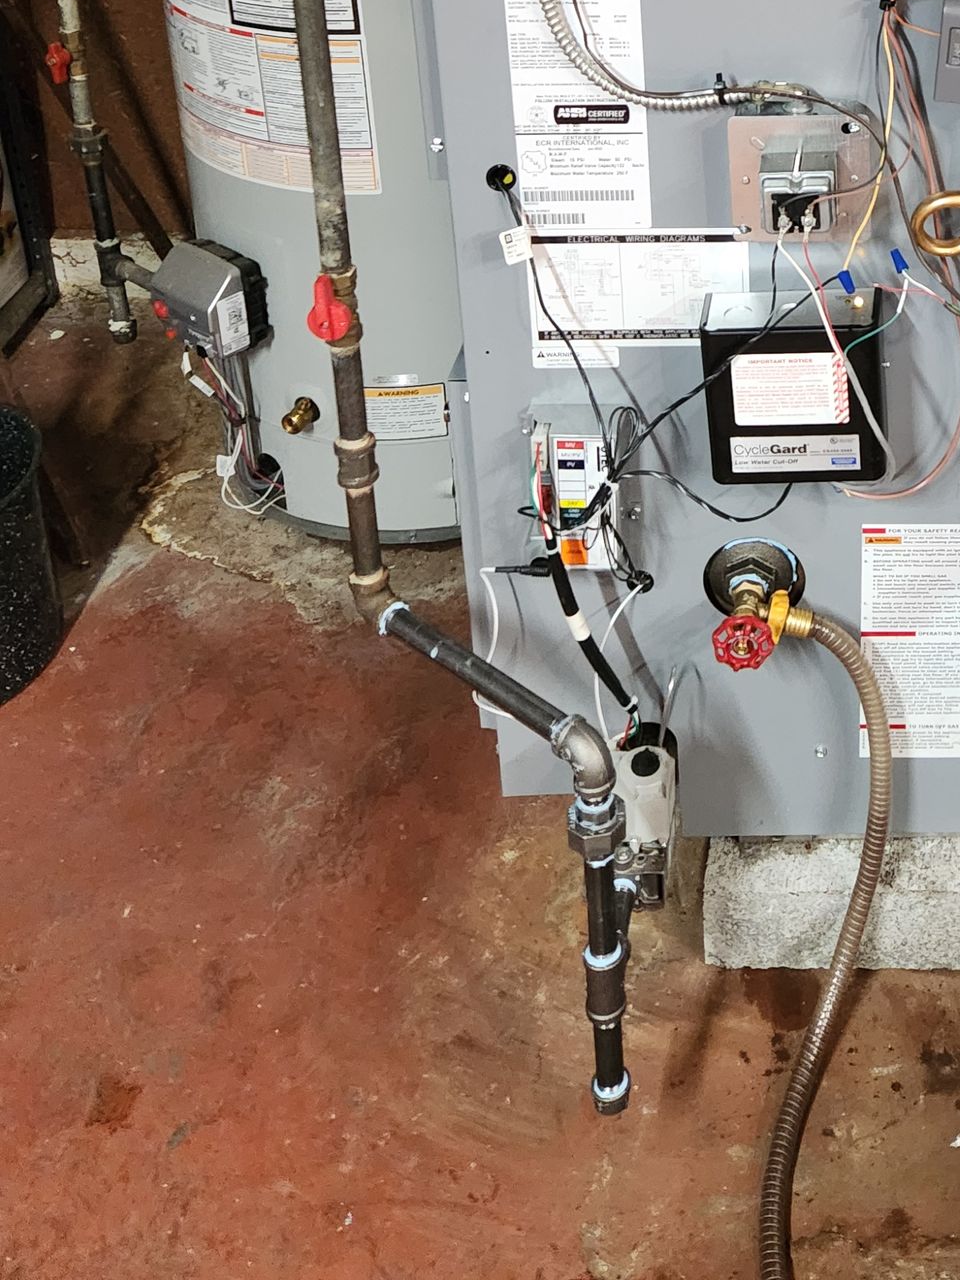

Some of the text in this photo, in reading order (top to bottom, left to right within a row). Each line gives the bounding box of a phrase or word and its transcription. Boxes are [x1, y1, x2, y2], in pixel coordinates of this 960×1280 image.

[587, 109, 626, 118] CERTIFIED
[535, 139, 553, 147] ECR
[567, 234, 706, 243] ELECTRICAL WIRING DIAGRAMS
[383, 389, 420, 397] WARNING
[733, 443, 808, 457] CycleGard
[772, 457, 799, 465] Cut-Off
